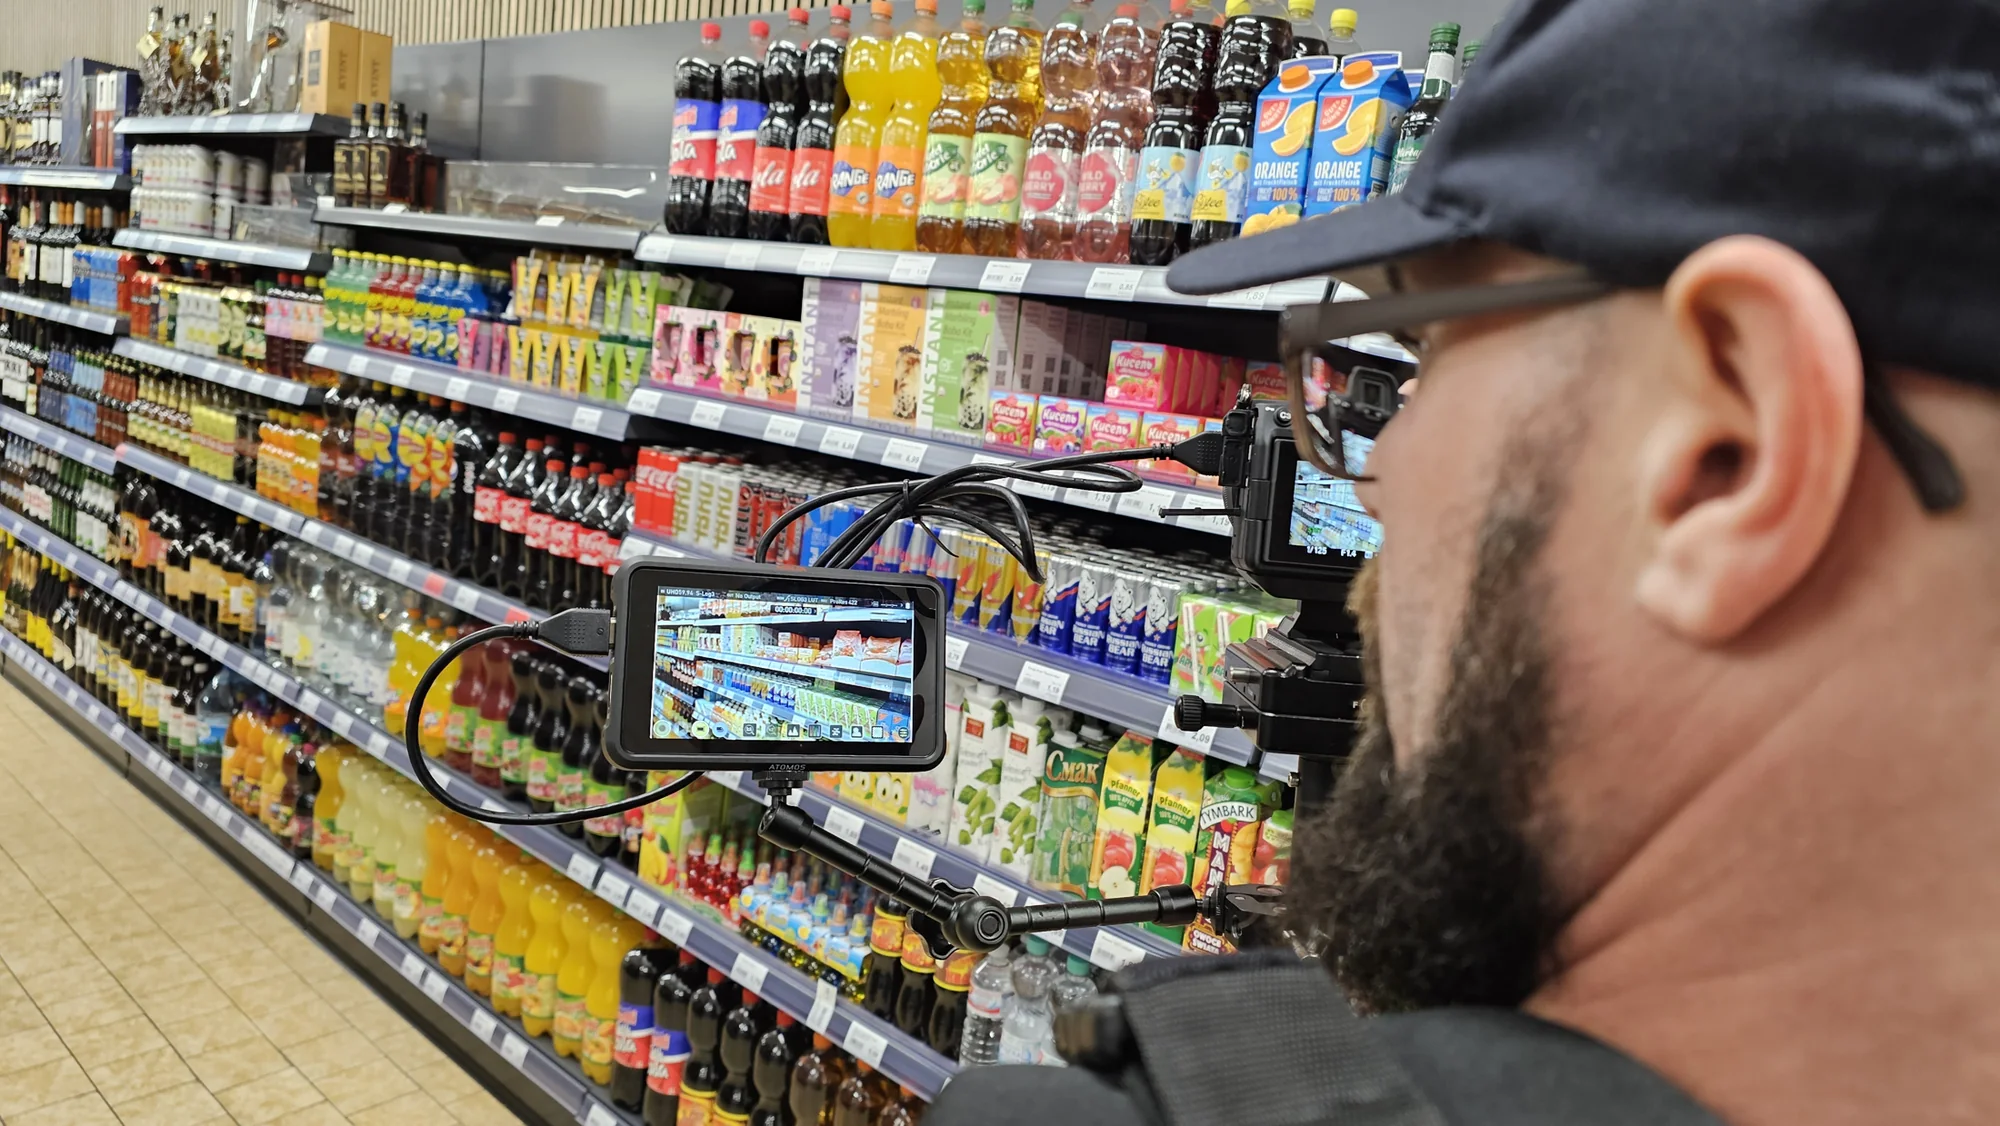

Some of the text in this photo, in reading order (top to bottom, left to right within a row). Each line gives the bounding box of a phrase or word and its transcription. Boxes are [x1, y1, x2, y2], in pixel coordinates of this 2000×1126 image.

[1254, 161, 1299, 180] ORANGE
[1314, 160, 1363, 179] ORANGE
[1272, 187, 1287, 200] 100
[1333, 188, 1349, 201] 100
[1245, 290, 1265, 301] 1,89
[799, 286, 821, 398] INSTANT
[857, 293, 878, 407] INSTANT
[921, 297, 946, 416] INSTANT
[1116, 355, 1153, 369] Кисель
[994, 403, 1026, 419] Кисель
[1043, 408, 1077, 424] Кисель
[1092, 420, 1128, 435] Кисель
[1095, 493, 1111, 502] 1,19
[734, 506, 750, 547] HELL
[1306, 545, 1327, 555] 1/125
[1340, 549, 1357, 558] F1.4
[1039, 625, 1057, 636] EAR
[1073, 633, 1098, 646] BEAR
[1108, 644, 1135, 657] BEAR
[1142, 654, 1169, 667] BEAR
[1191, 731, 1210, 743] 2,09
[1046, 750, 1100, 785] Смак
[1110, 779, 1140, 798] pfanner
[1160, 796, 1191, 815] pfanner
[1200, 805, 1255, 825] TYMBARK
